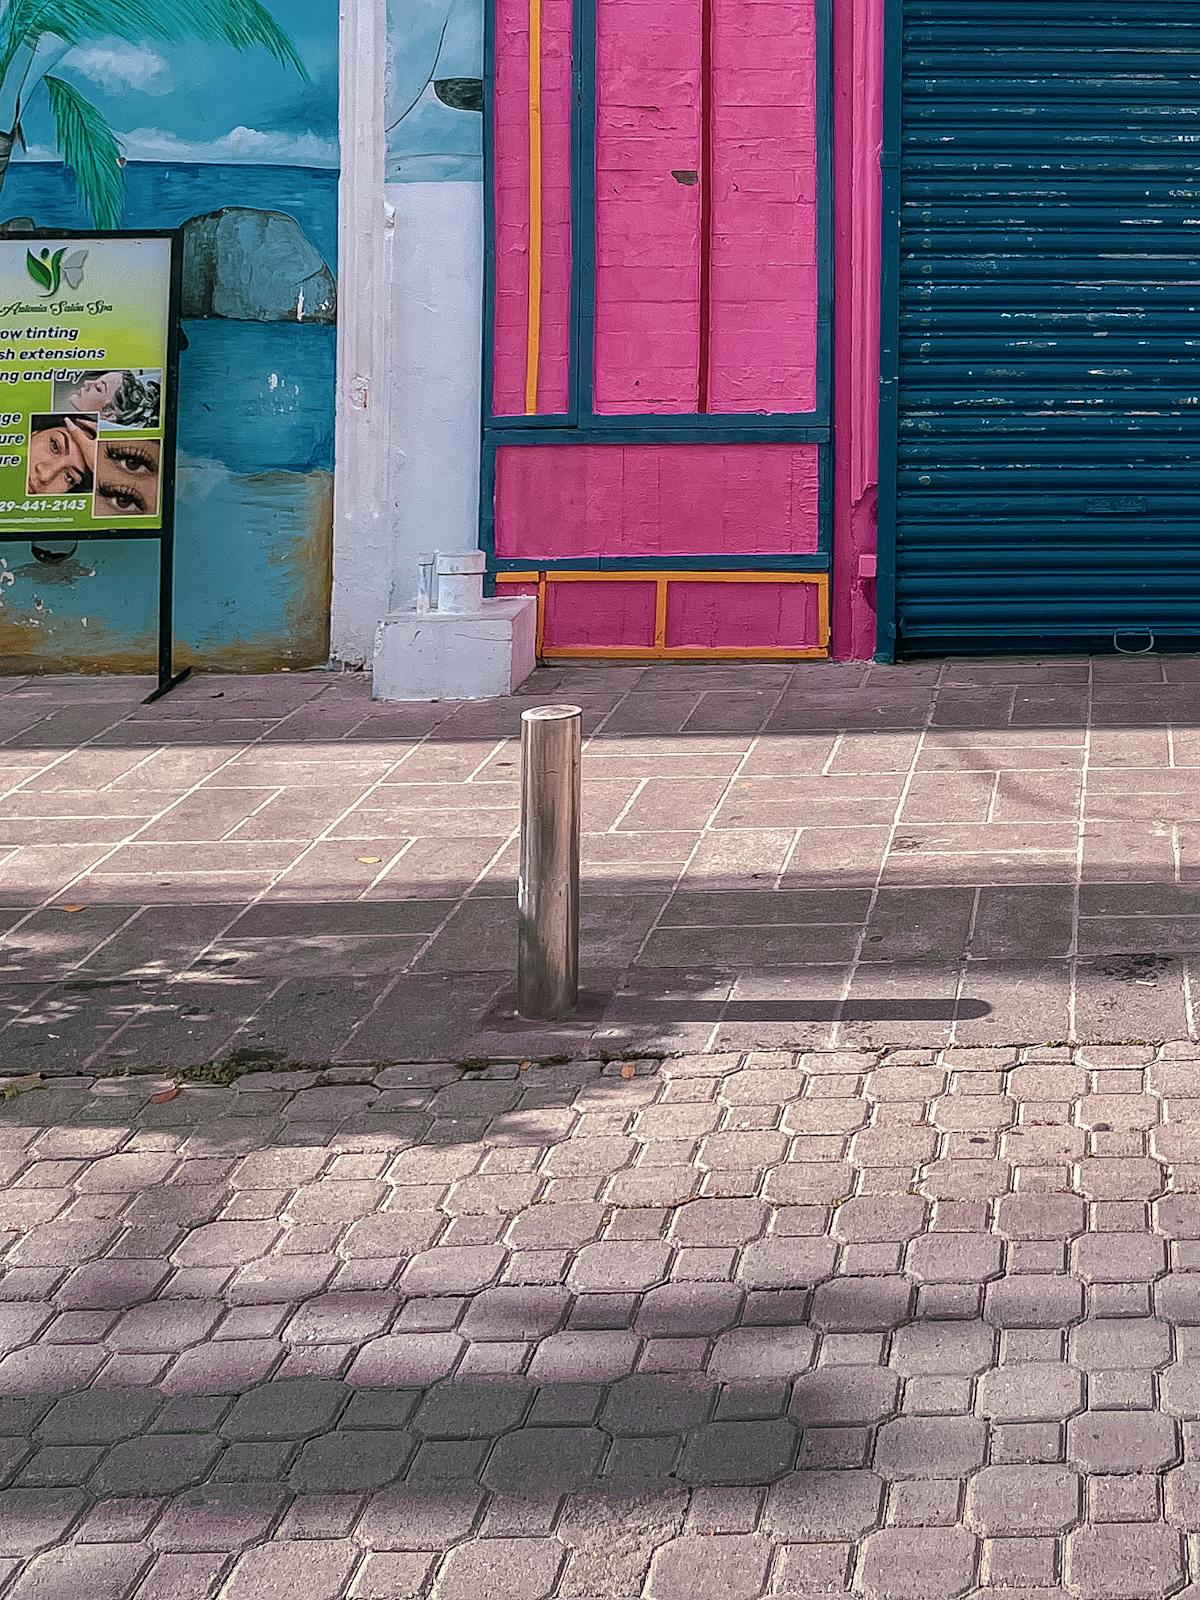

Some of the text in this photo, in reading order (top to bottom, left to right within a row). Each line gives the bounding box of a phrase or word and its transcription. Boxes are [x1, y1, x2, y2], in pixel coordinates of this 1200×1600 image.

[86, 300, 113, 316] Spa
[0, 327, 79, 341] ow tinting
[20, 346, 106, 360] extensions
[23, 369, 54, 381] and
[56, 369, 83, 383] dry
[0, 413, 22, 427] ge
